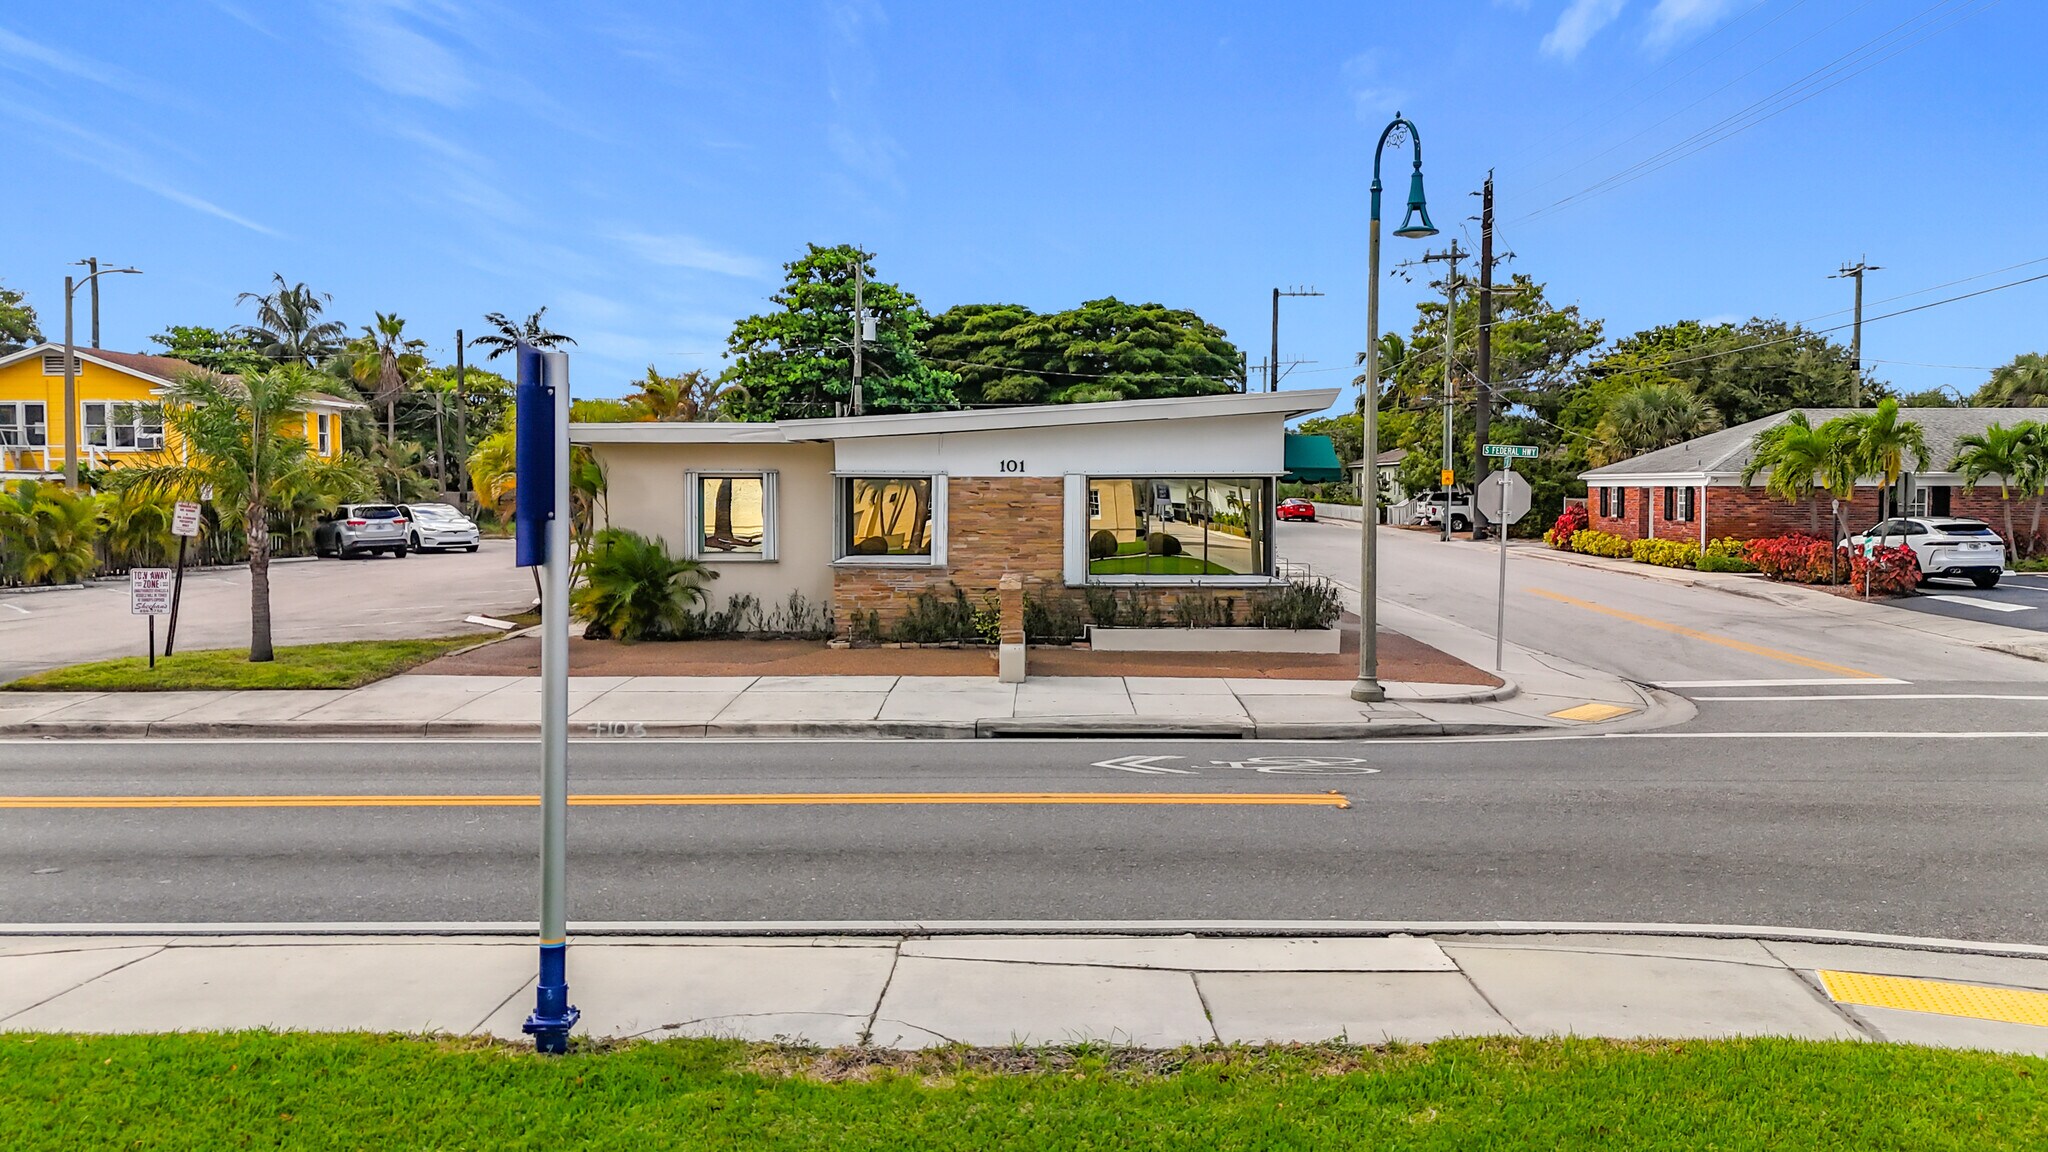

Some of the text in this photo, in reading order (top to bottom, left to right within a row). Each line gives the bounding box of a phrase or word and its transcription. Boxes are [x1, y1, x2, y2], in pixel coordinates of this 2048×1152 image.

[1492, 446, 1520, 455] FEDERAL
[1522, 447, 1537, 456] HWY
[1000, 460, 1025, 473] 101
[150, 571, 168, 579] AWAY
[143, 580, 159, 588] ZONE
